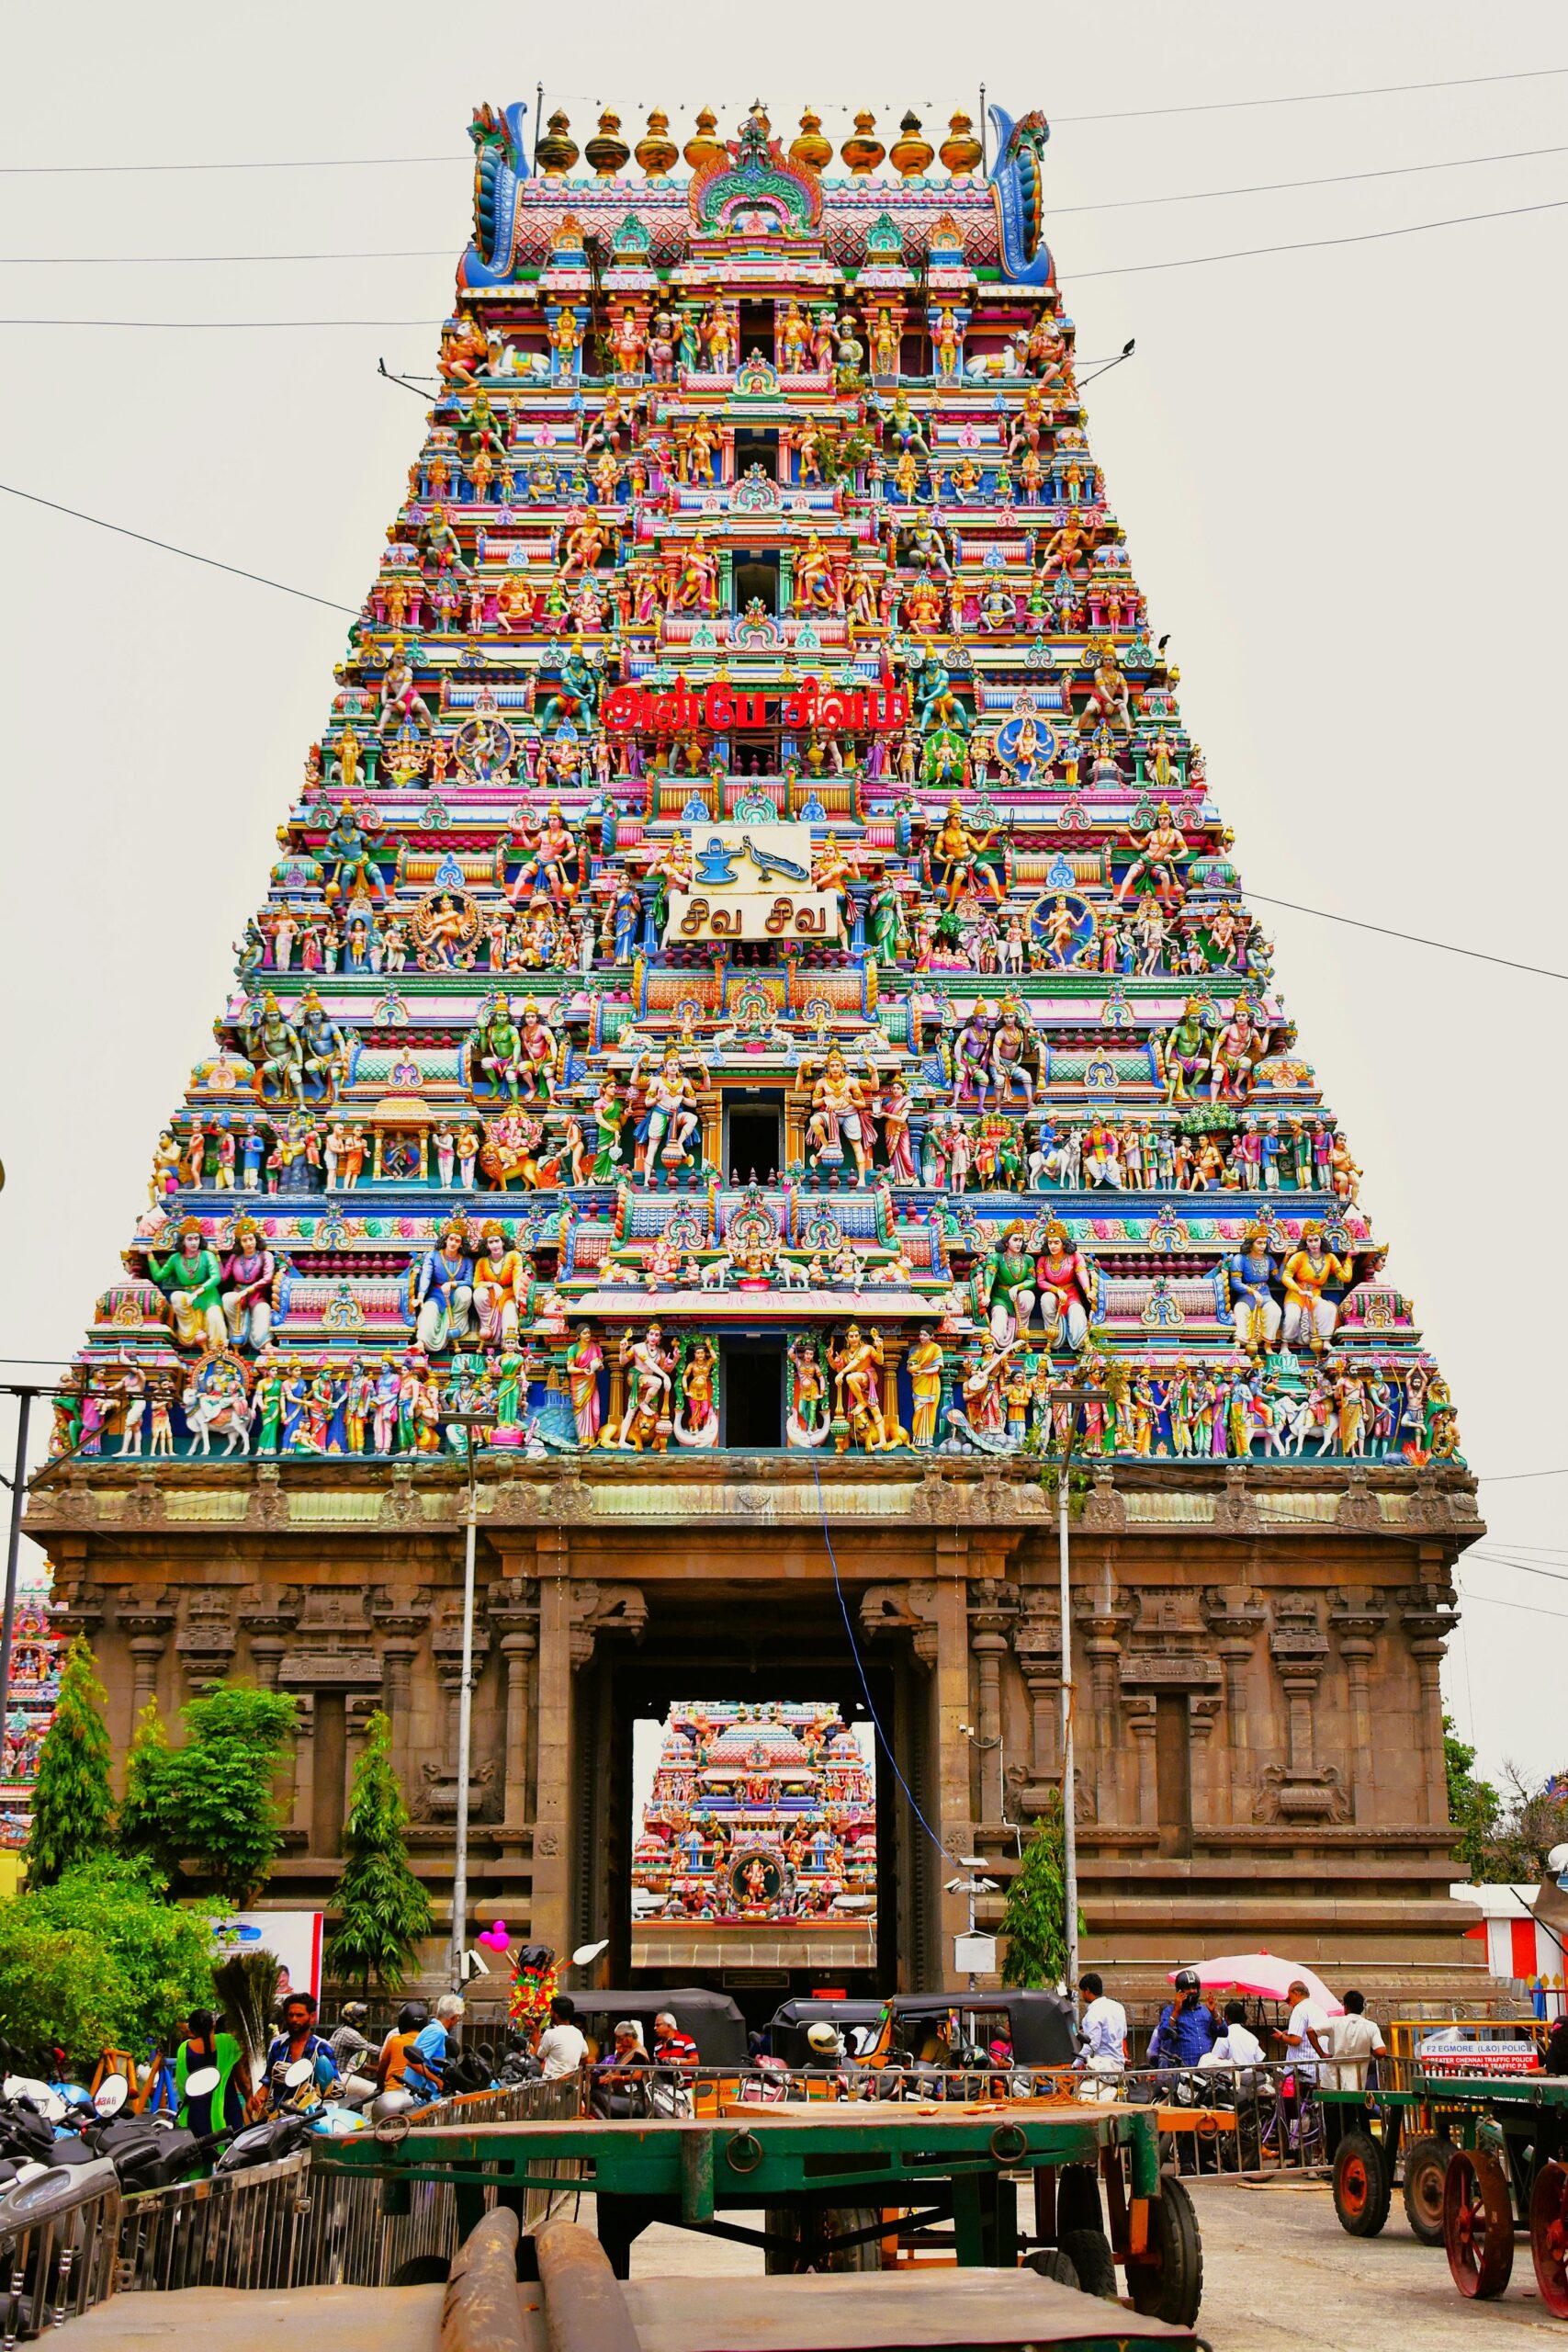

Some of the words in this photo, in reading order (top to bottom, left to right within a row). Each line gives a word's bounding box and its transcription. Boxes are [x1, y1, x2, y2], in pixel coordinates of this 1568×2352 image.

[600, 675, 767, 730] அன்பே
[786, 673, 908, 729] சிவம்
[681, 898, 742, 934] சிவ
[765, 897, 827, 933] சிவ
[1478, 2044, 1500, 2053] (L&O)
